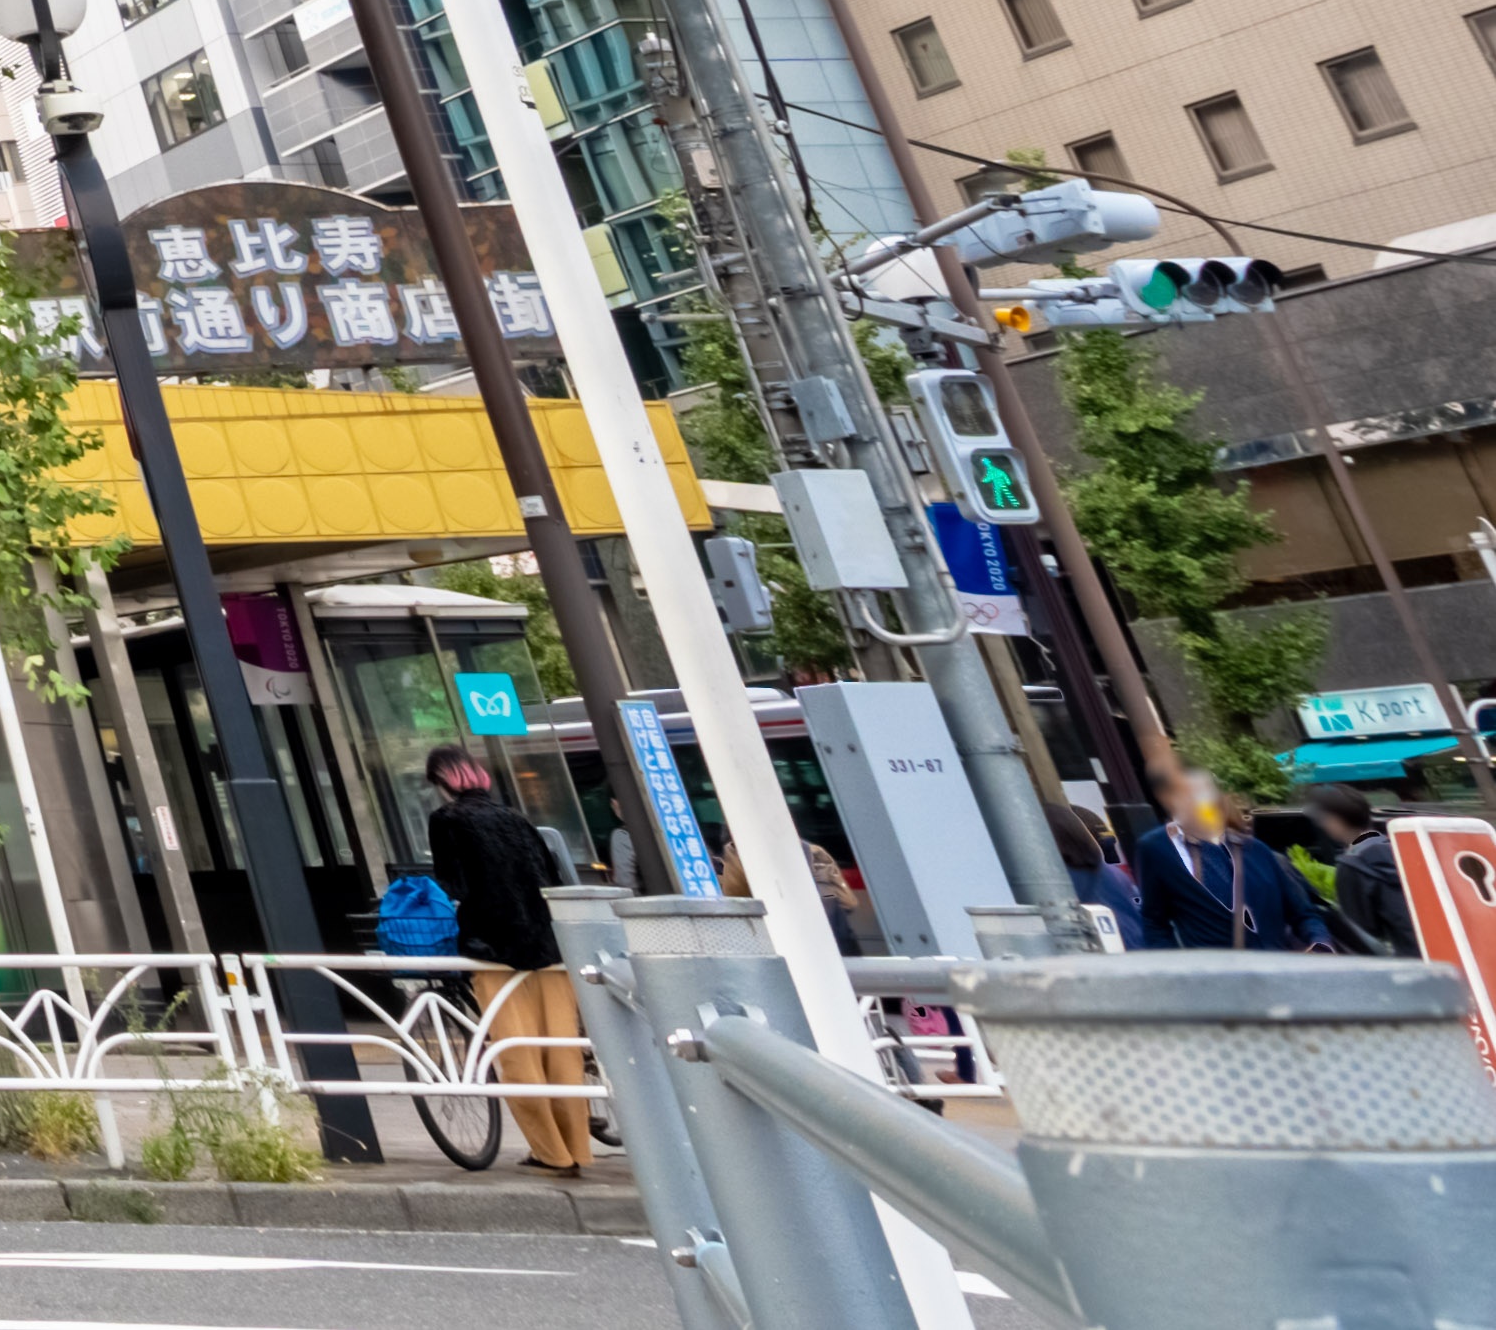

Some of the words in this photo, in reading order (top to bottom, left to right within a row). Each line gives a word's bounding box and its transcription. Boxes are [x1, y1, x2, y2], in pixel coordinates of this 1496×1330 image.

[148, 214, 384, 282] 恵比寿
[976, 521, 998, 557] OKYO
[985, 559, 1006, 591] 2020
[276, 607, 293, 642] TOKYO
[284, 643, 300, 669] 2020
[887, 759, 945, 774] 331-67
